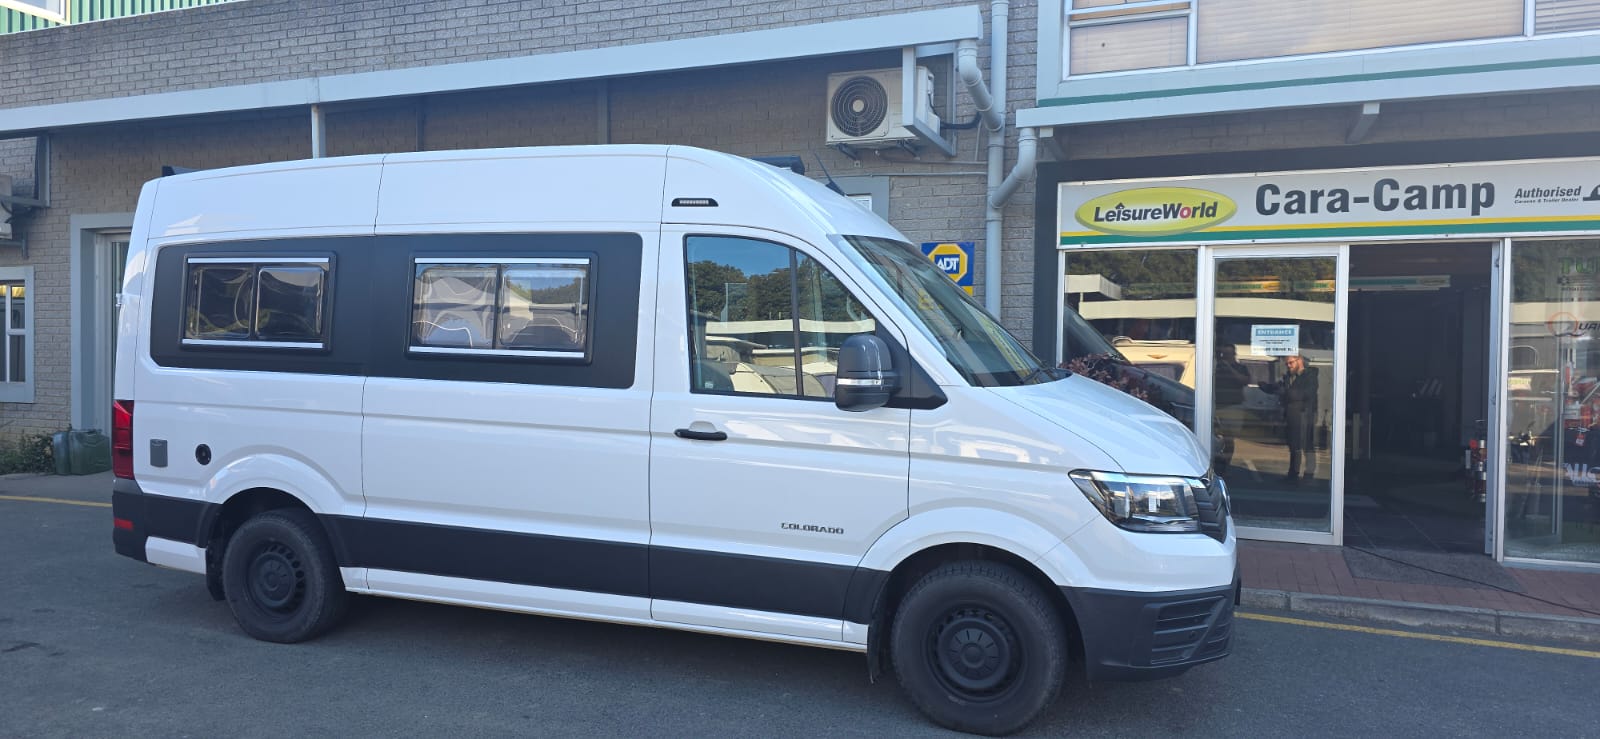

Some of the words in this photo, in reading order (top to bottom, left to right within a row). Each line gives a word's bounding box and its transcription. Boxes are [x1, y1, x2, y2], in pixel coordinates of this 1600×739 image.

[1255, 177, 1496, 217] Cara-Camp
[1514, 186, 1582, 199] Authorised
[1093, 201, 1218, 222] LeisureWorld
[936, 257, 960, 271] ADT
[781, 522, 844, 535] COLORADO
